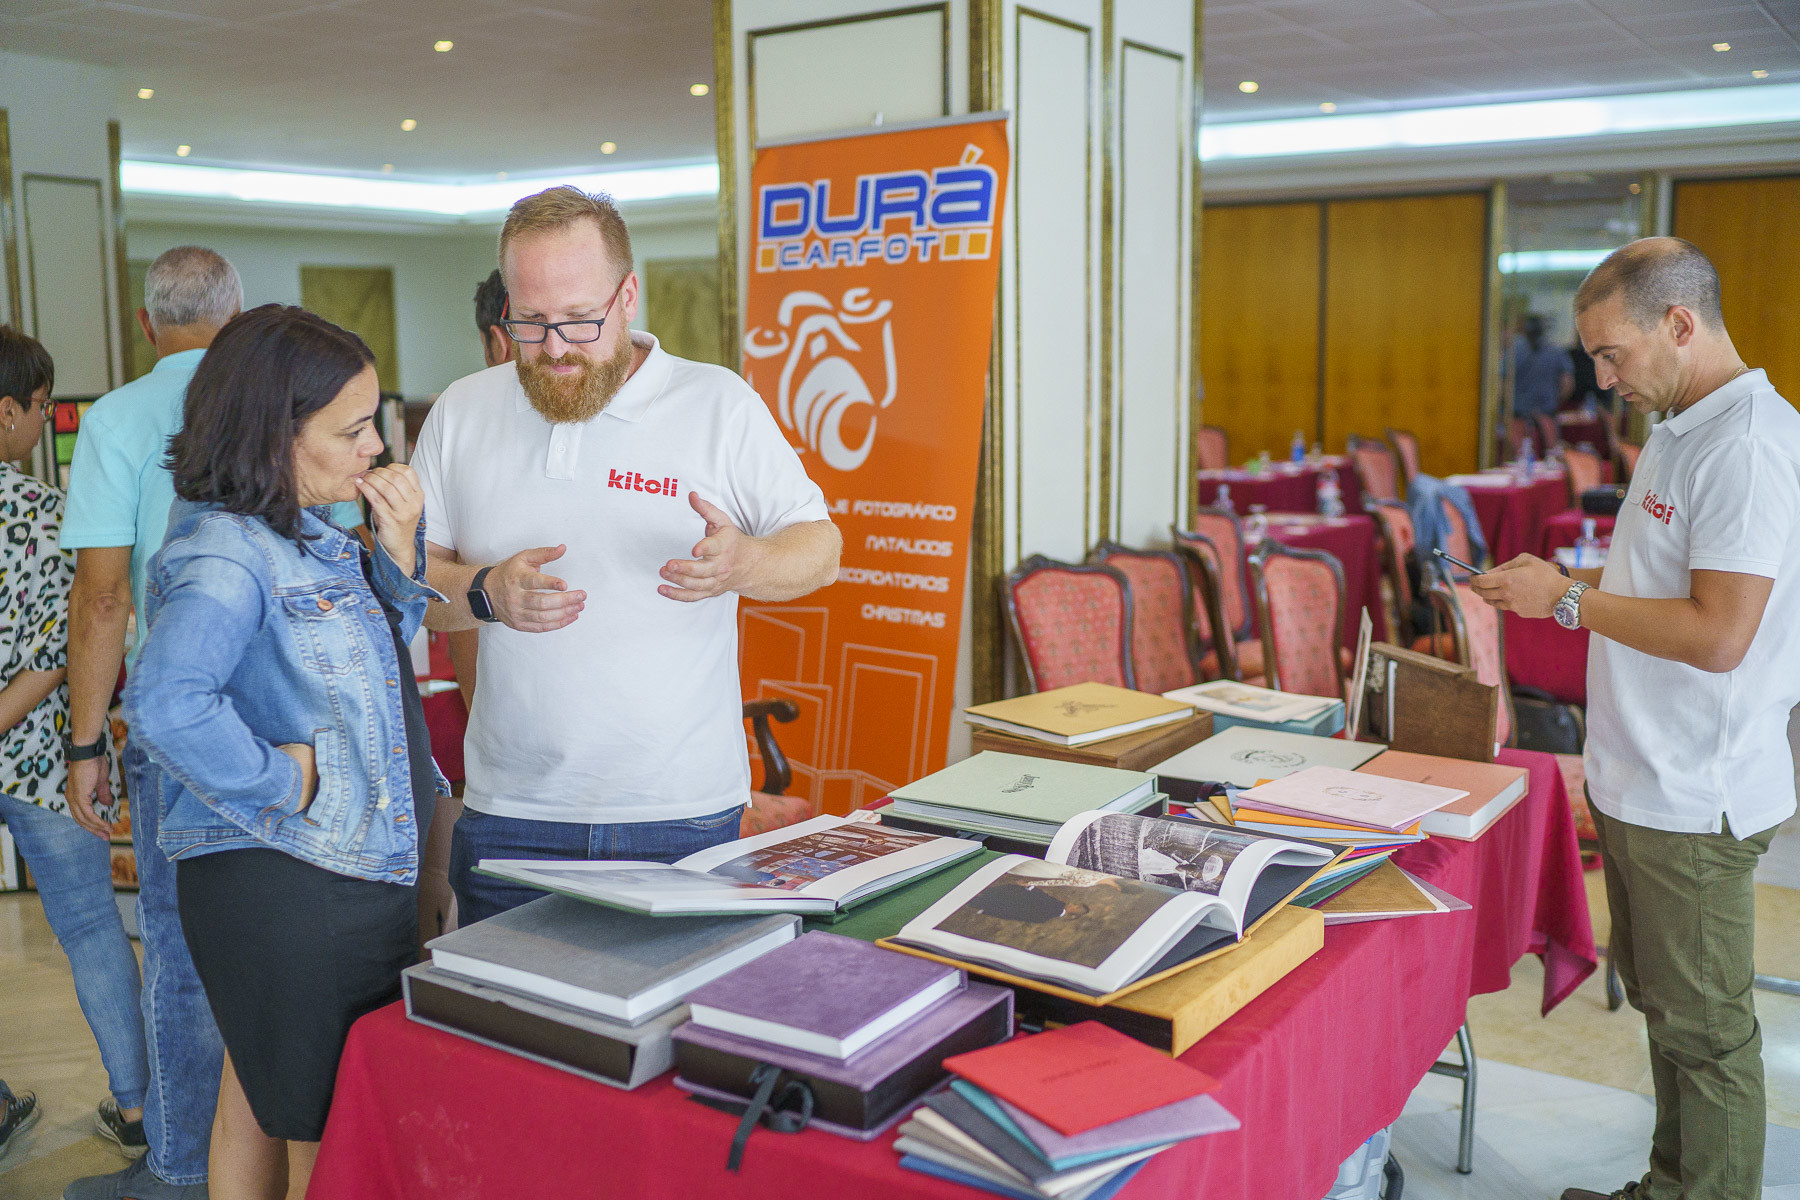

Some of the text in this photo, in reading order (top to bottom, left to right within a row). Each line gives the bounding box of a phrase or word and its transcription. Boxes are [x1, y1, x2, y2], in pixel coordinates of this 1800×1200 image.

[779, 231, 939, 271] CARFOT
[607, 468, 678, 497] kitoli
[837, 566, 949, 593] ECORDATORIOS
